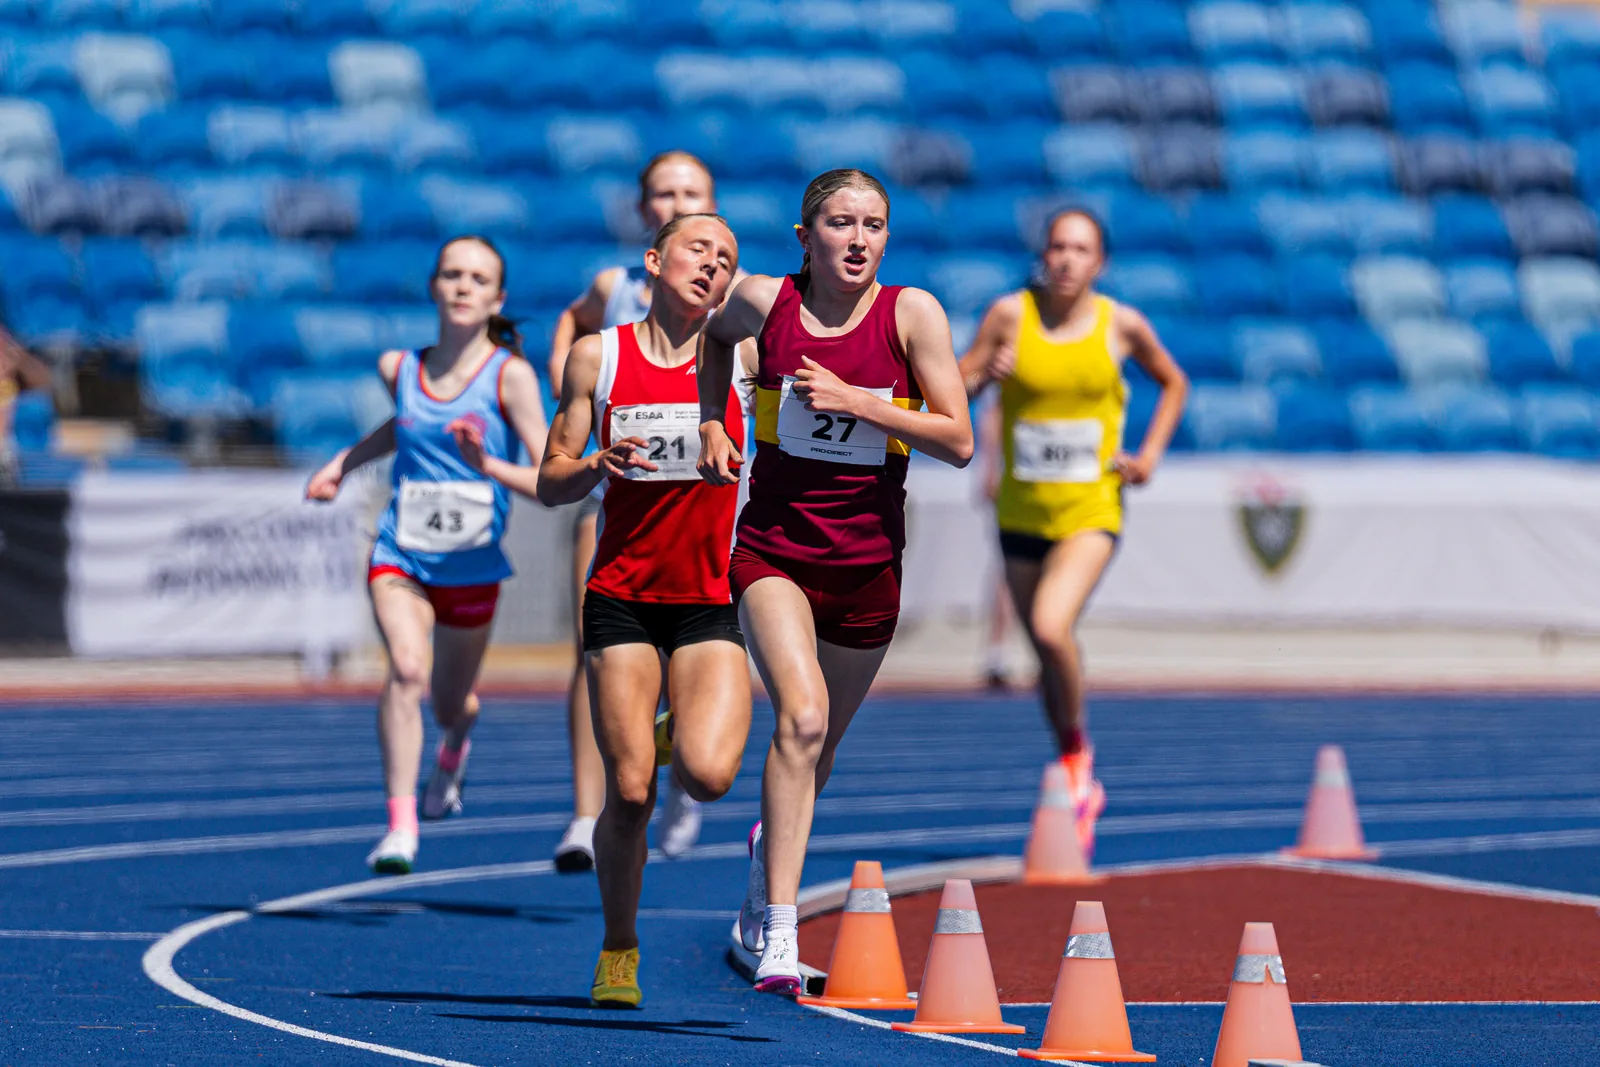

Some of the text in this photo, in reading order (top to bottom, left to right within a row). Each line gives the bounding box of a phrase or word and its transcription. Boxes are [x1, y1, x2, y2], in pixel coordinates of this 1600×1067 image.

[635, 411, 664, 420] ESAA
[811, 413, 858, 443] 27
[648, 435, 686, 461] 21
[427, 510, 465, 533] 43
